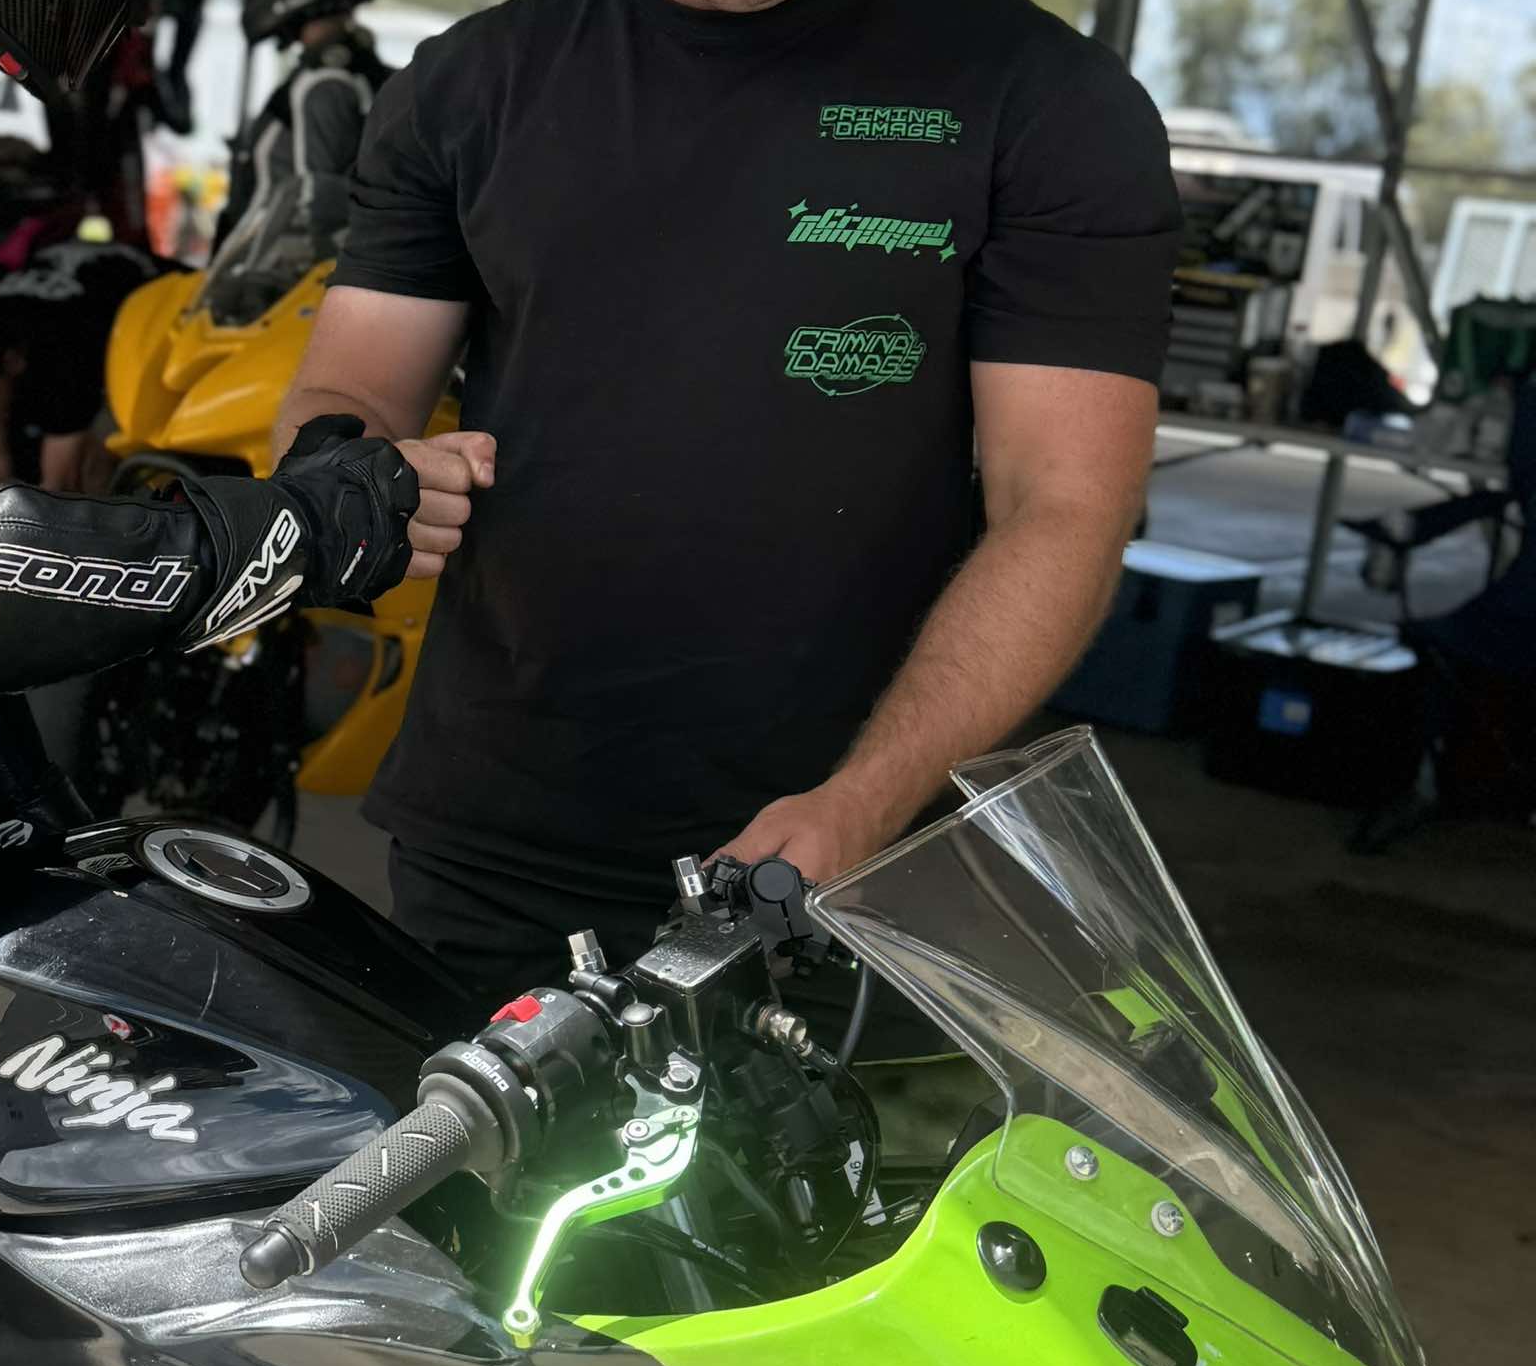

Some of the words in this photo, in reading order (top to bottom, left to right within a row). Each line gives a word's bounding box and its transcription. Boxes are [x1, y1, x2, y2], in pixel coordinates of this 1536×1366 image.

[820, 106, 961, 133] CRIMINAL
[833, 121, 943, 141] DAMAGE
[789, 329, 925, 355] CRIMINAL
[786, 350, 921, 379] DAMAGE
[462, 1050, 509, 1092] domino
